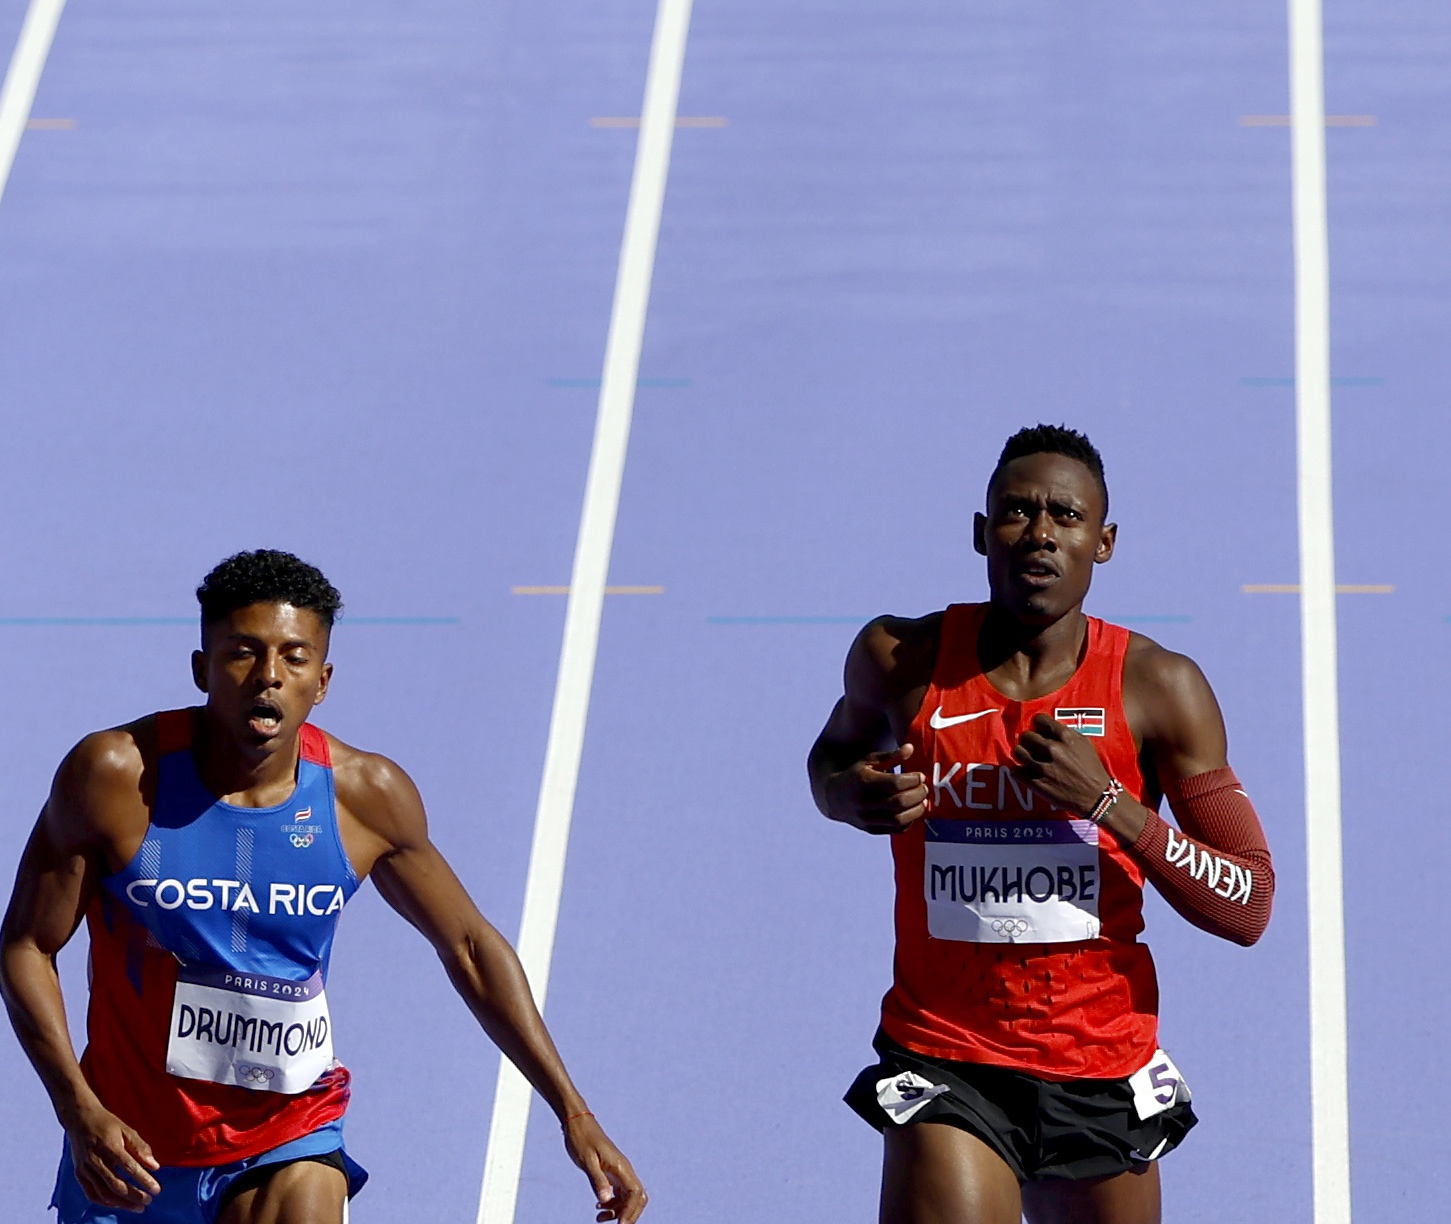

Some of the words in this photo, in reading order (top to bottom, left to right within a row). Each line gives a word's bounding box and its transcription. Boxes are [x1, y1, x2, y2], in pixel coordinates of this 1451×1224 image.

[965, 826, 1008, 838] PARIS
[1013, 826, 1054, 838] 2024
[930, 863, 1096, 903] MUKHOBE
[1165, 827, 1252, 905] KENYA
[125, 879, 260, 913] COSTA
[269, 884, 345, 916] RICA
[224, 974, 269, 992] PARIS
[272, 982, 310, 997] 2024
[178, 1004, 328, 1056] DRUMMOND
[1149, 1063, 1178, 1104] 5
